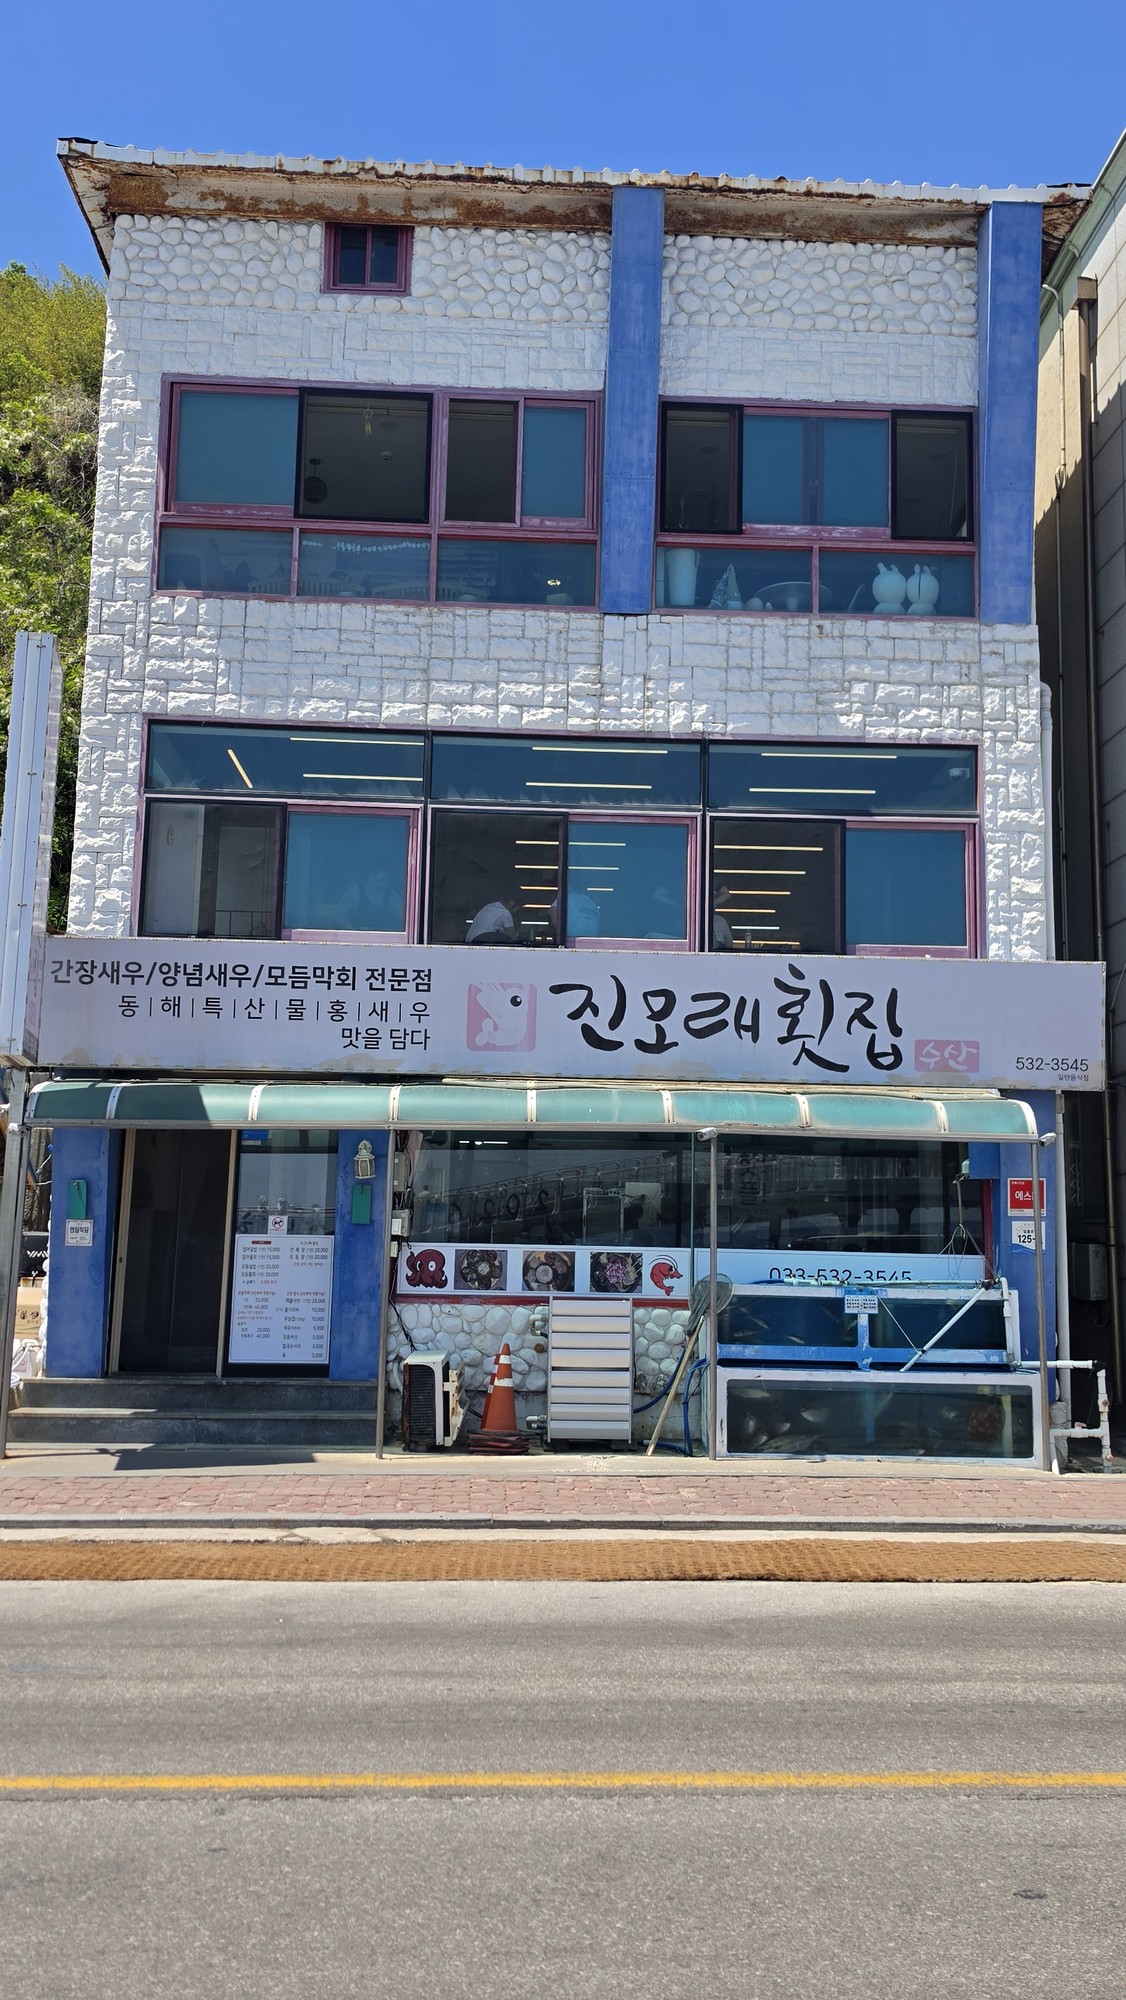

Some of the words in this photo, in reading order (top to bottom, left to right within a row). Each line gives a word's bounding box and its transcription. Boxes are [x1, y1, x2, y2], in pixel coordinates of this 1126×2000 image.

[51, 959, 357, 990] 간장새우/양념새우/모듬막회
[365, 967, 432, 992] 전문점
[341, 1027, 383, 1050] 맛을
[389, 1028, 431, 1050] 담다
[919, 1041, 977, 1071] 수산
[1015, 1056, 1089, 1072] 532-3545
[1057, 1074, 1089, 1082] 일반음식점
